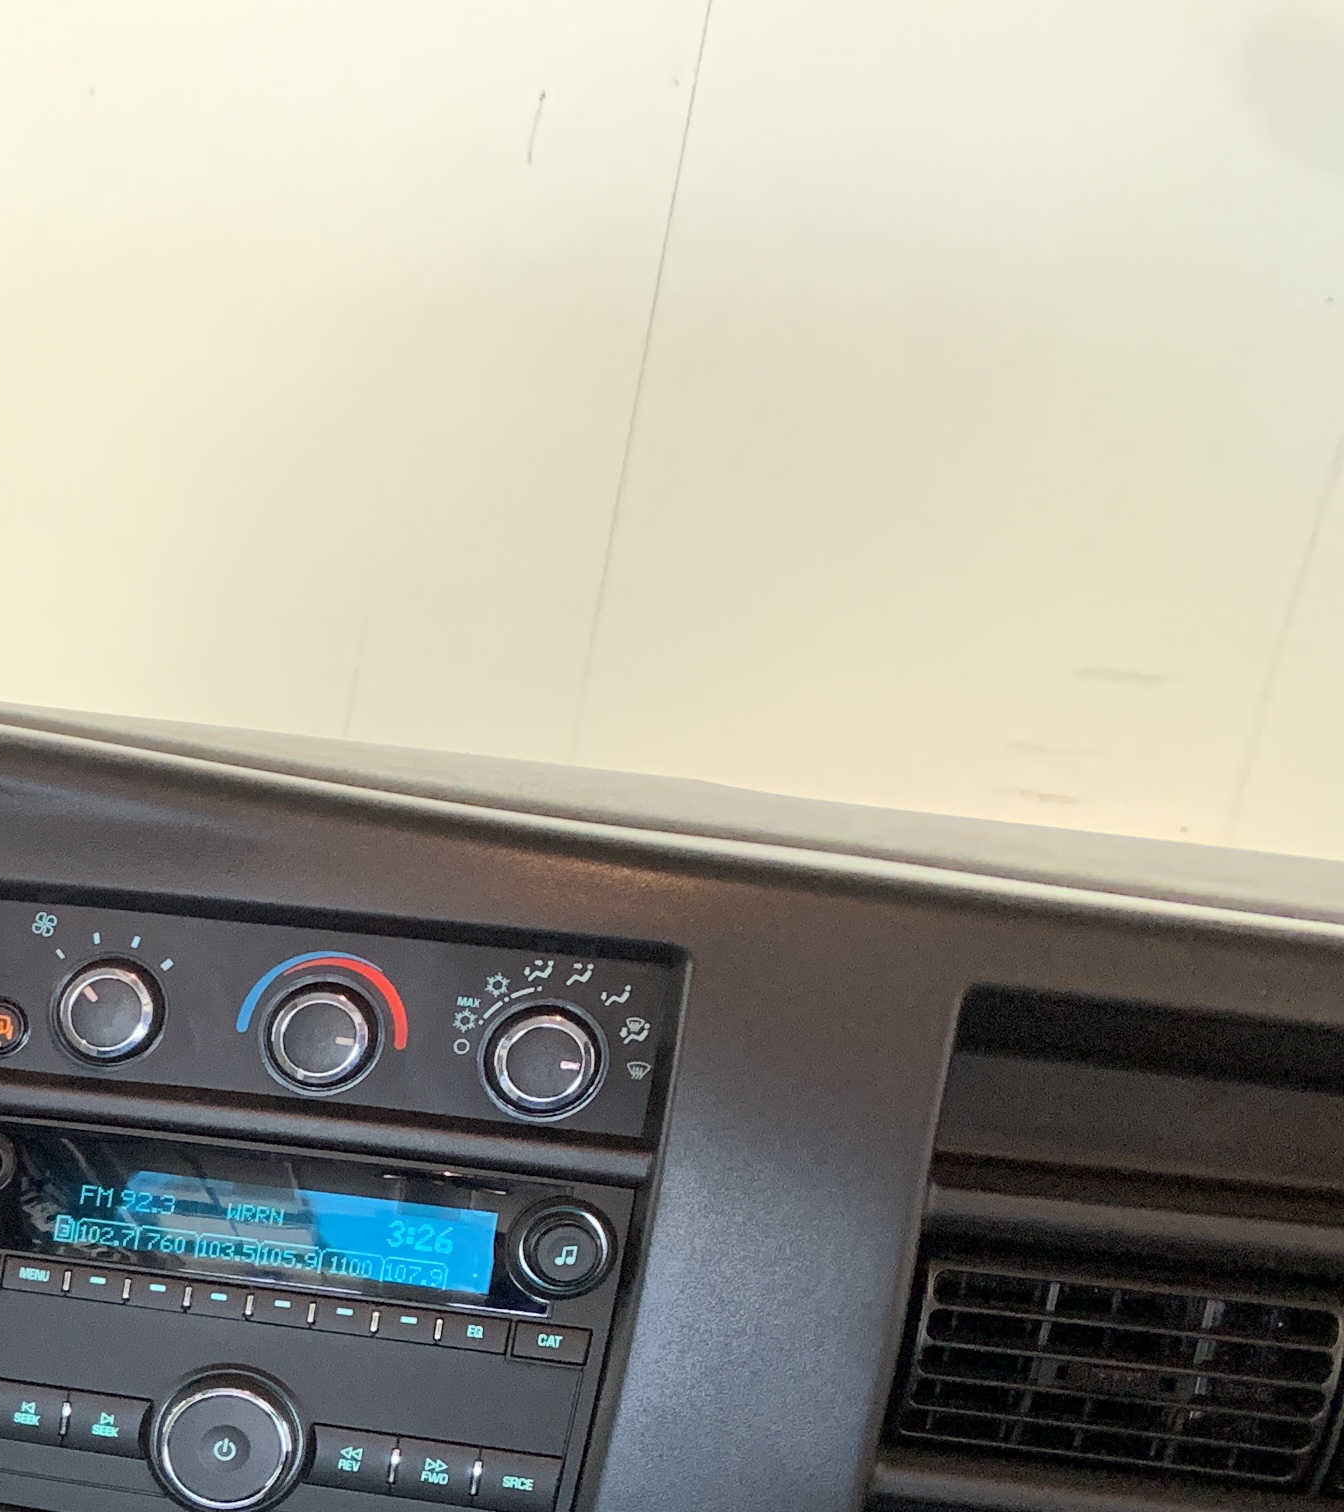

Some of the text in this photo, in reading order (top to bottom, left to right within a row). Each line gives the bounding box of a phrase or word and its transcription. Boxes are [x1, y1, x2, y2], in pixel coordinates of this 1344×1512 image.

[456, 996, 482, 1008] MAX
[79, 1184, 176, 1215] FM 92.3
[226, 1203, 285, 1226] WRRN
[386, 1220, 454, 1255] 3:26
[78, 1224, 135, 1247] 102.7
[147, 1233, 186, 1254] 760
[200, 1239, 256, 1262] 103.5
[261, 1247, 317, 1271] 105.9
[330, 1256, 373, 1278] 1100
[385, 1264, 444, 1287] 107.9
[18, 1266, 50, 1282] MENU
[466, 1324, 484, 1339] EQ
[537, 1333, 563, 1349] CAT
[13, 1412, 41, 1426] SEEK
[91, 1423, 119, 1438] SEEK
[337, 1458, 361, 1472] REV
[420, 1470, 449, 1485] FWD
[502, 1475, 535, 1492] SRCE
